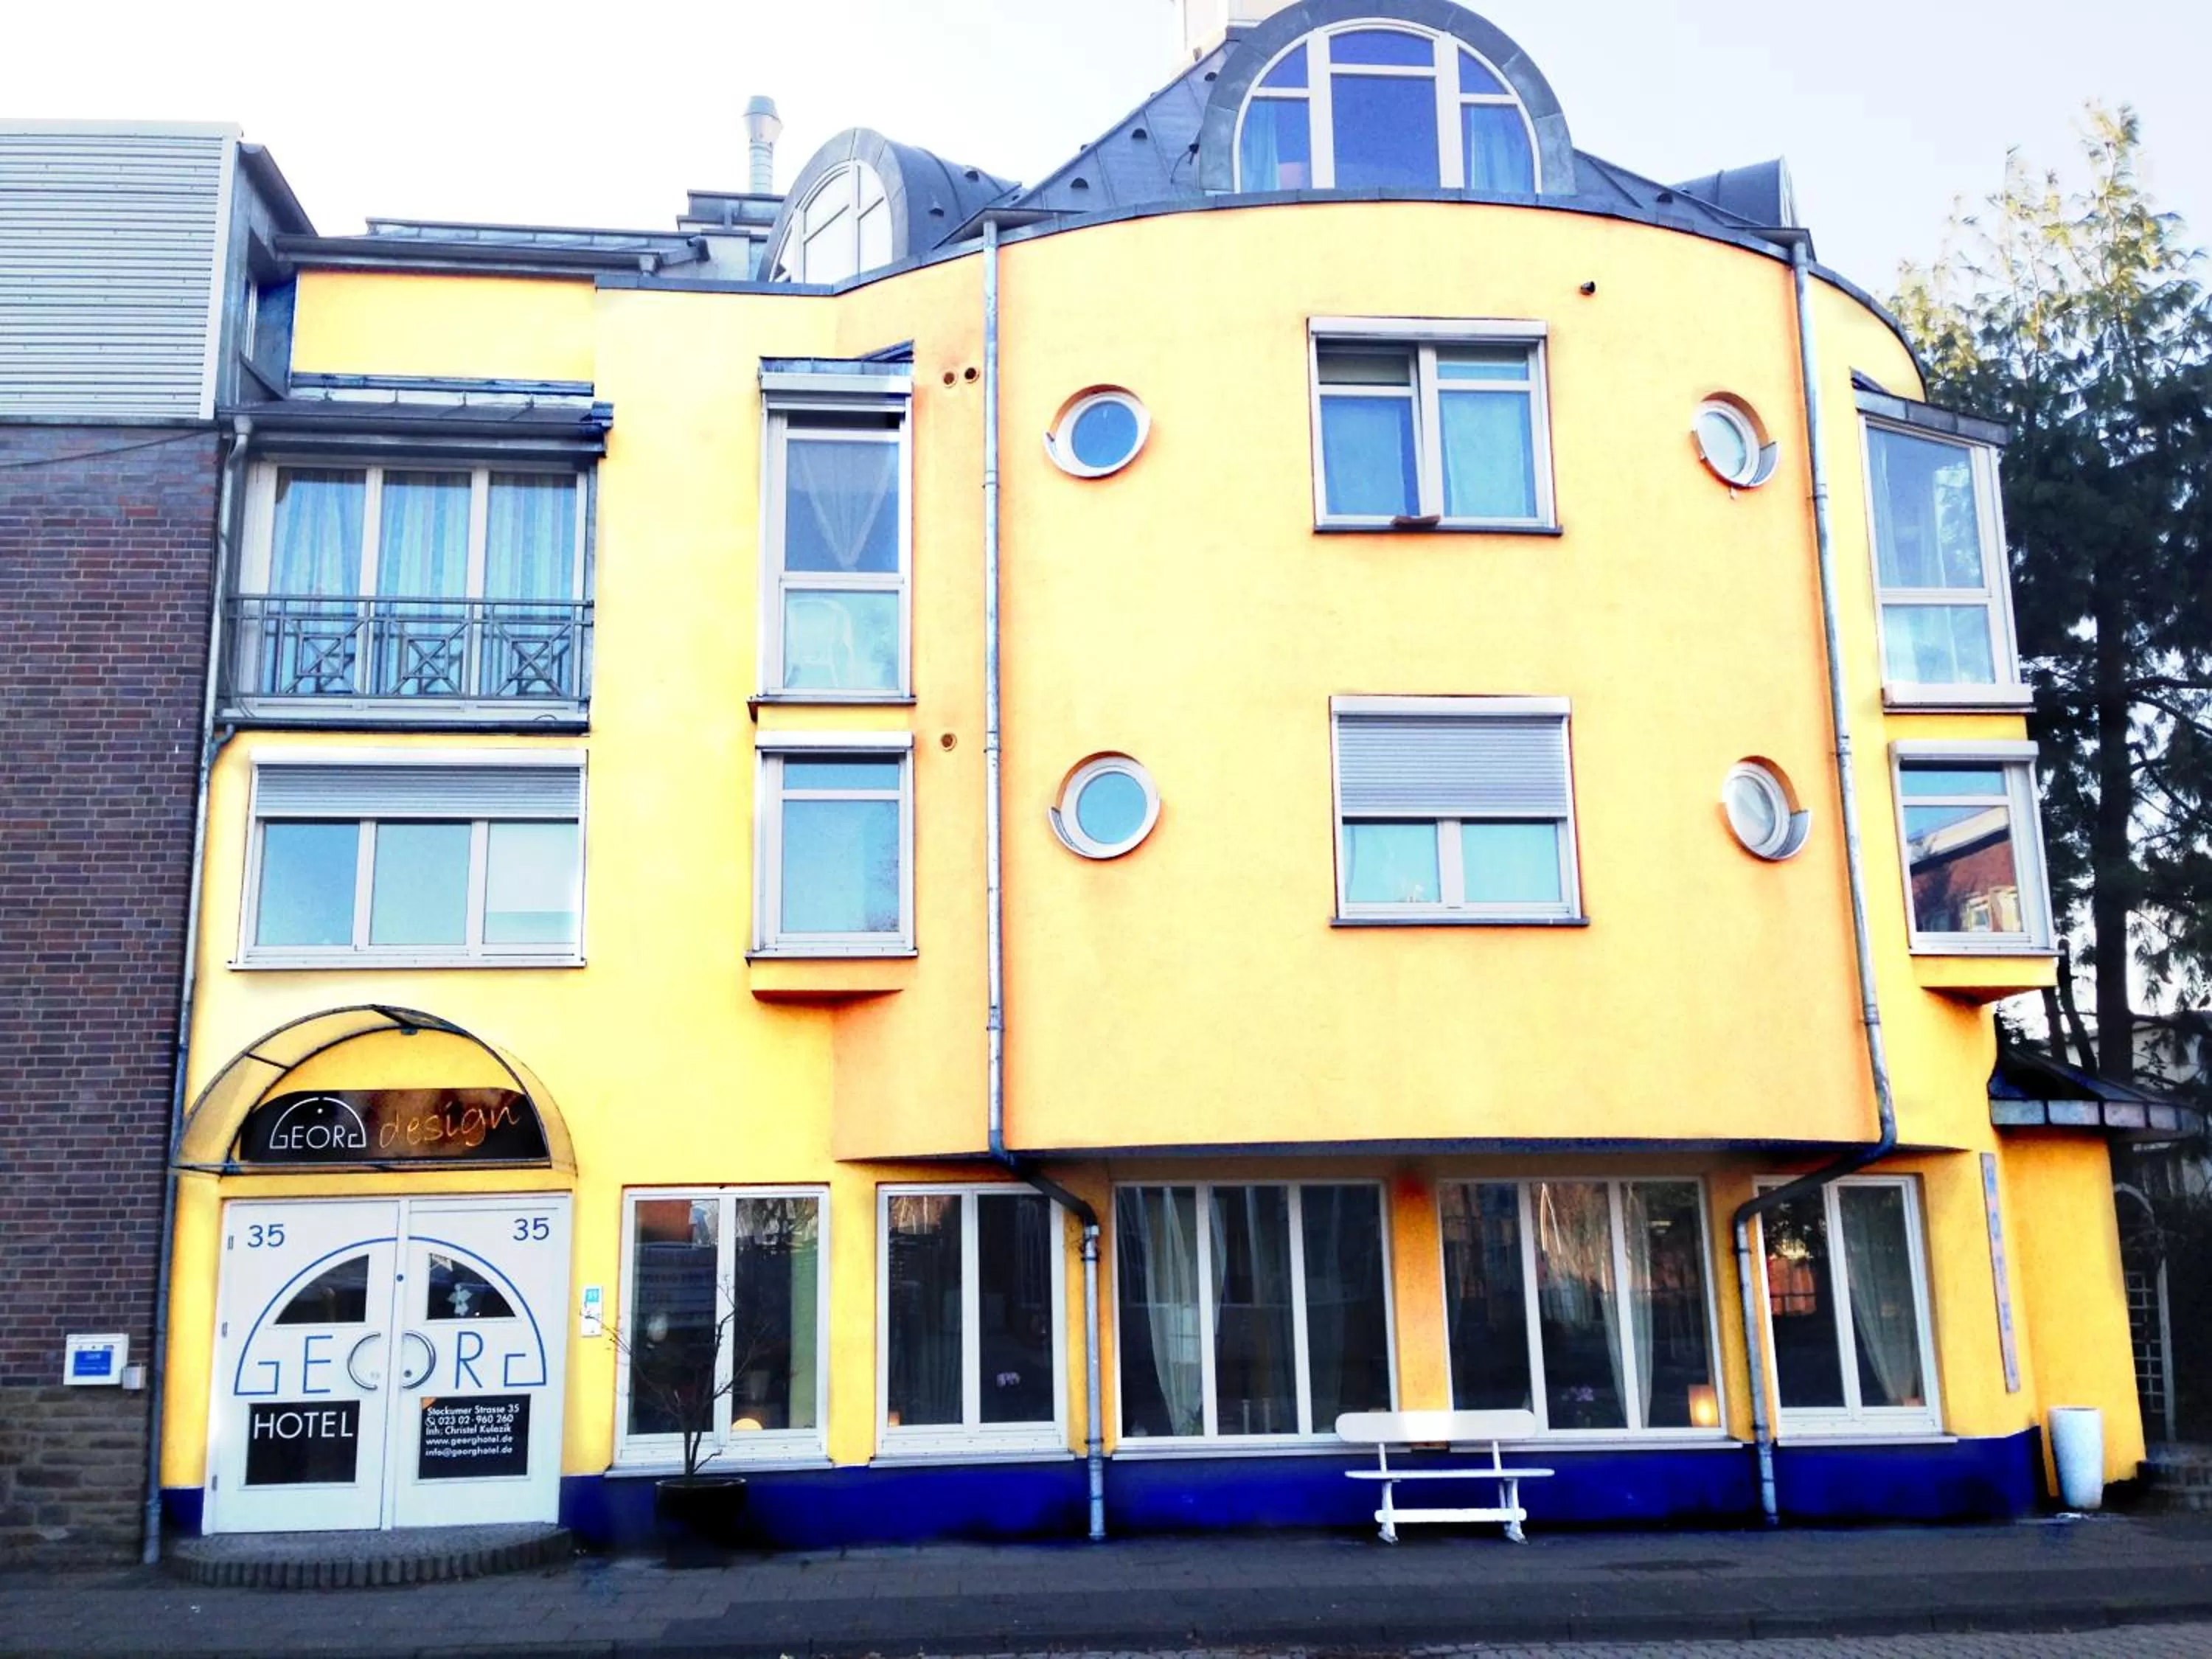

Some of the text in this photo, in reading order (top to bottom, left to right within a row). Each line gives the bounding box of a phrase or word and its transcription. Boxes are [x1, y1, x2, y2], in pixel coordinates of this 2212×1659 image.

[269, 1101, 522, 1150] GEORG design
[247, 1223, 286, 1248] 35
[512, 1217, 551, 1242] 35
[233, 1330, 547, 1396] GEORG
[427, 1403, 520, 1416] Stockumer Strasse 35
[437, 1416, 456, 1425] 023
[495, 1413, 514, 1423] 260
[252, 1411, 354, 1439] HOTEL
[445, 1424, 477, 1436] Christel
[425, 1434, 513, 1447] www.georghotel.de
[425, 1445, 513, 1458] info@georghotel.de
